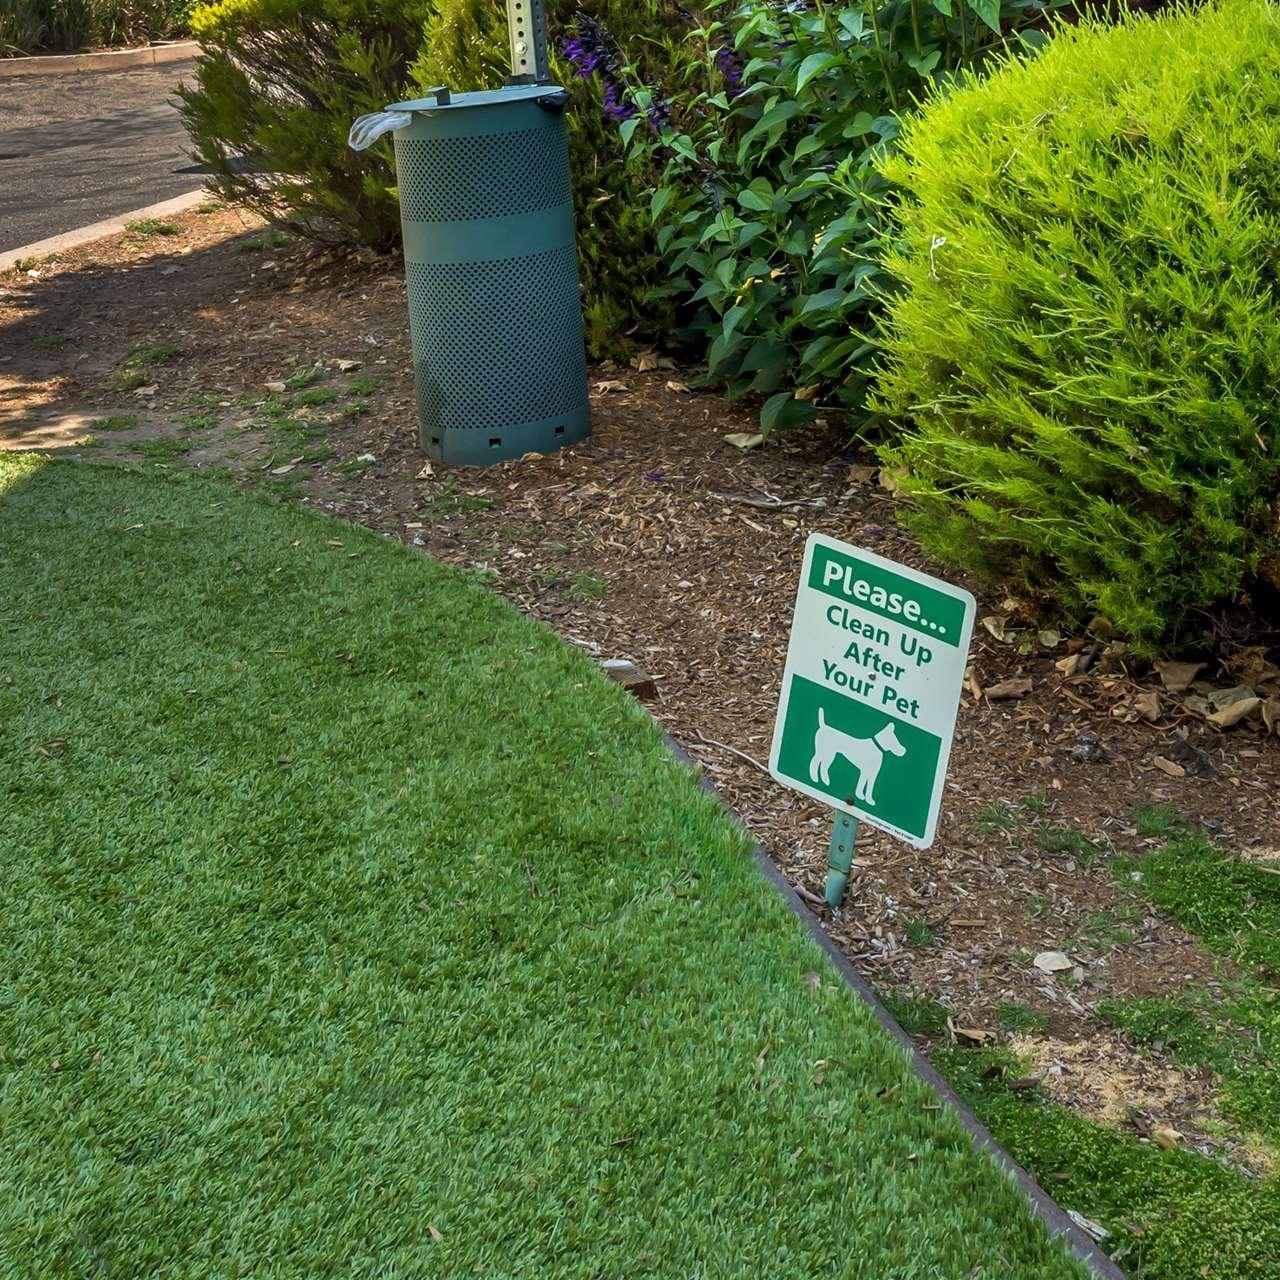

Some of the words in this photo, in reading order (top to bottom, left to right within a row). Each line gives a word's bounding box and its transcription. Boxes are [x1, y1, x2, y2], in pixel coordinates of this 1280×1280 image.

[822, 559, 947, 635] Please...
[826, 605, 891, 647] Clean
[900, 633, 933, 667] Up
[843, 642, 906, 681] After
[822, 658, 874, 697] Your
[881, 685, 920, 719] Pet
